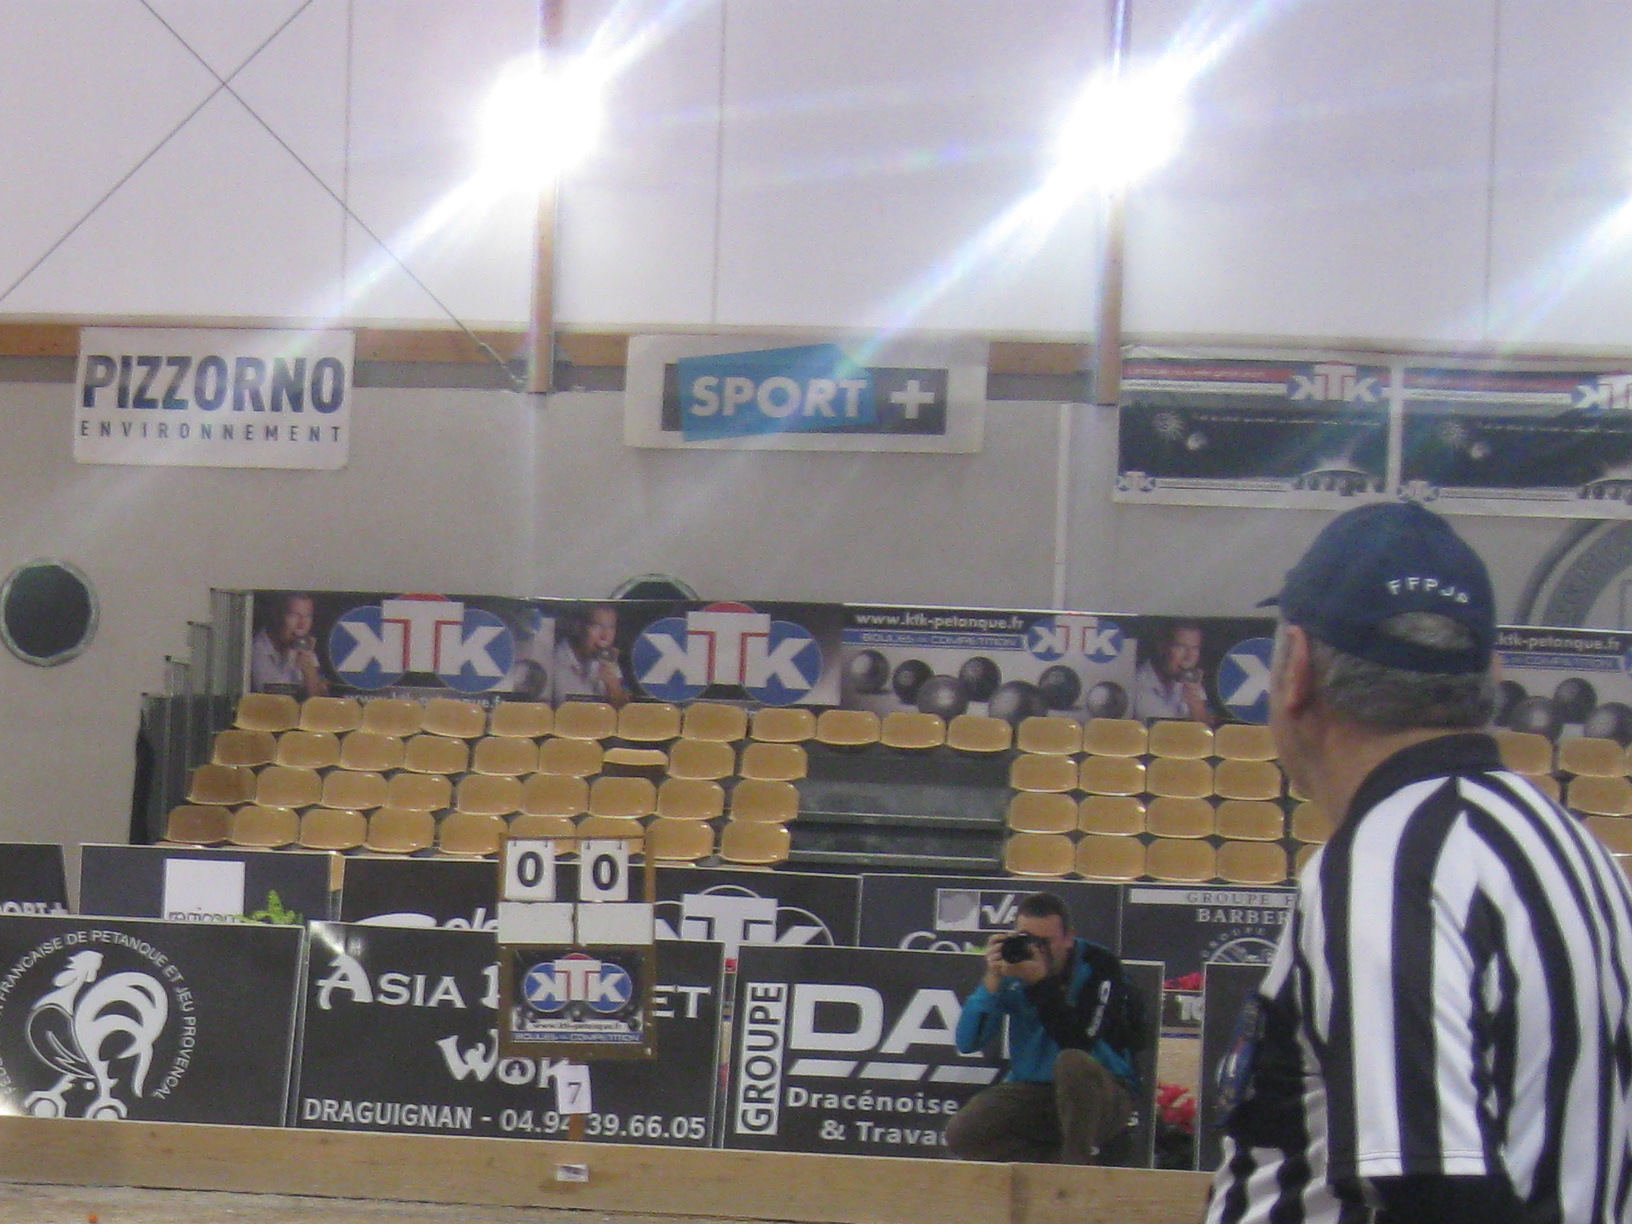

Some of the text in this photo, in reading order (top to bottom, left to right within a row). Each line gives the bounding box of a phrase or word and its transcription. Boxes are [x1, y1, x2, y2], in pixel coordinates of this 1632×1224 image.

[82, 355, 346, 413] PIZZORNO
[691, 375, 868, 419] SPORT
[1576, 374, 1632, 409] KT
[79, 420, 342, 442] ENVIRONNEMENT
[337, 599, 475, 677] KTK
[855, 612, 1025, 629] www.ktk-petanque.fr
[1032, 615, 1121, 656] KTK
[640, 611, 817, 690] KTK
[1495, 633, 1621, 650] .ktk-petanque.fr
[517, 851, 619, 891] 0 0
[1186, 892, 1271, 902] GROUPE
[1196, 908, 1291, 925] BARBER
[67, 930, 88, 945] DE
[92, 930, 167, 967] PETANQUE
[162, 964, 185, 984] ET
[175, 985, 194, 1013] JEU
[527, 959, 626, 1003] KTK
[790, 984, 1010, 1059] DA
[741, 984, 784, 1132] GROUPE
[567, 1081, 582, 1105] 7
[786, 1086, 960, 1116] Dracénoise
[303, 1098, 473, 1130] DRAGUIGNAN
[820, 1119, 948, 1146] & Trava
